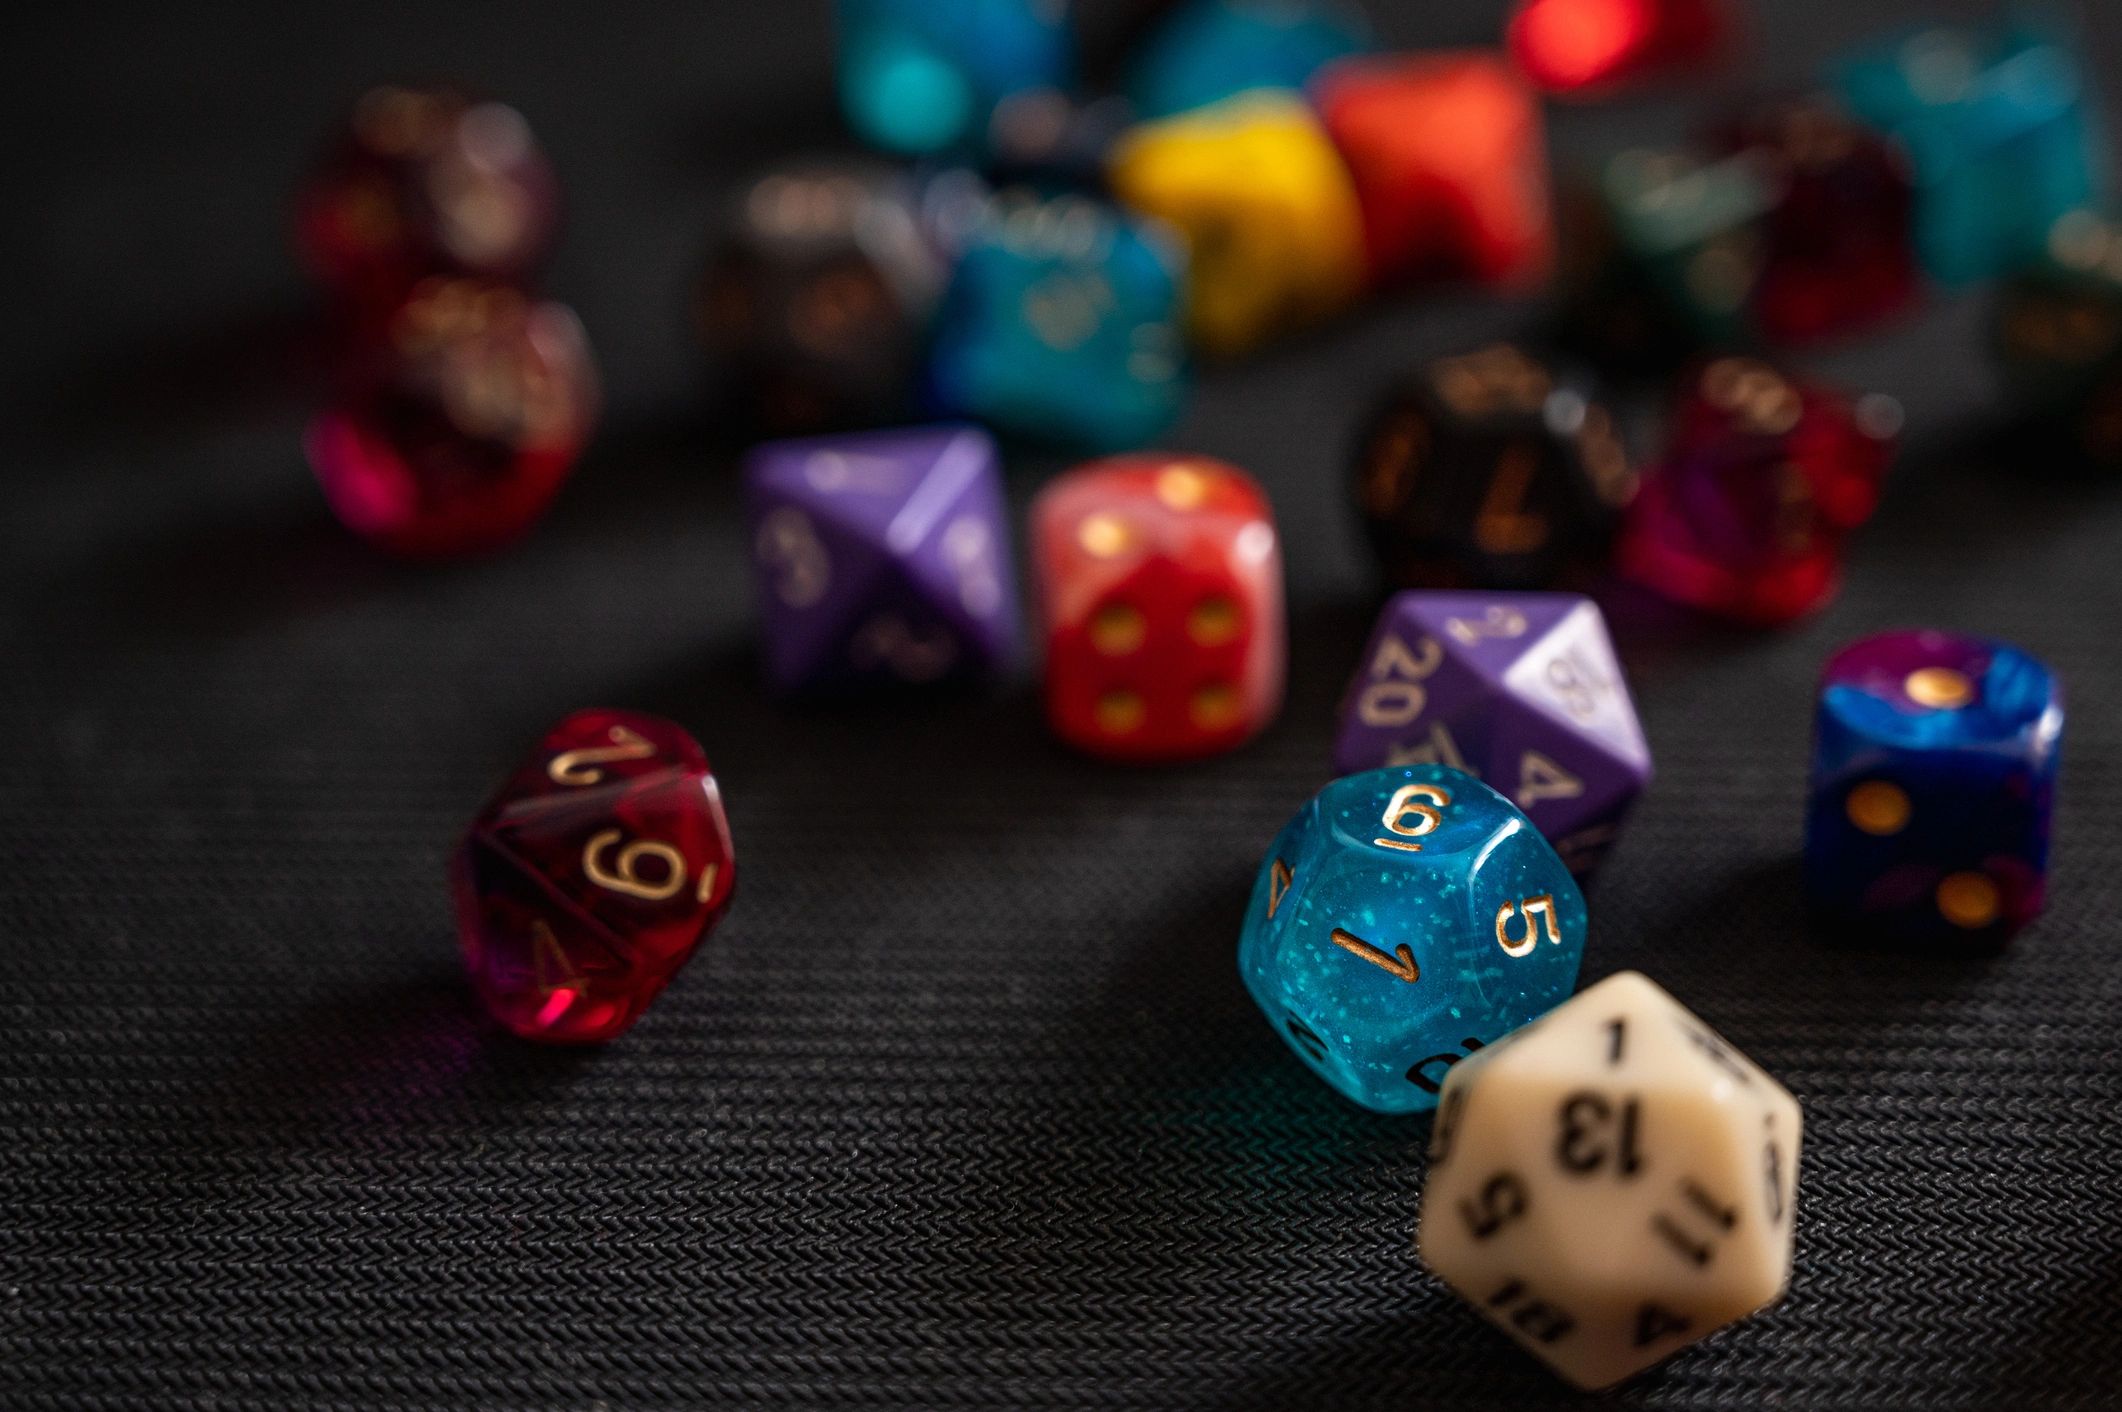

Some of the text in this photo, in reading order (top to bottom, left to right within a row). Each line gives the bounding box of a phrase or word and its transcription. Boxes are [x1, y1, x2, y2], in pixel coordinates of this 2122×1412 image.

[1359, 634, 1443, 728] 20
[547, 725, 657, 786] 2
[1517, 752, 1586, 808] 4
[1374, 784, 1452, 852] 6
[581, 828, 719, 903] 6
[1495, 893, 1562, 958] 5
[1601, 1014, 1627, 1065] 1
[1553, 1089, 1646, 1181] 13
[1456, 1170, 1530, 1242] 5
[1651, 1179, 1740, 1269] 11
